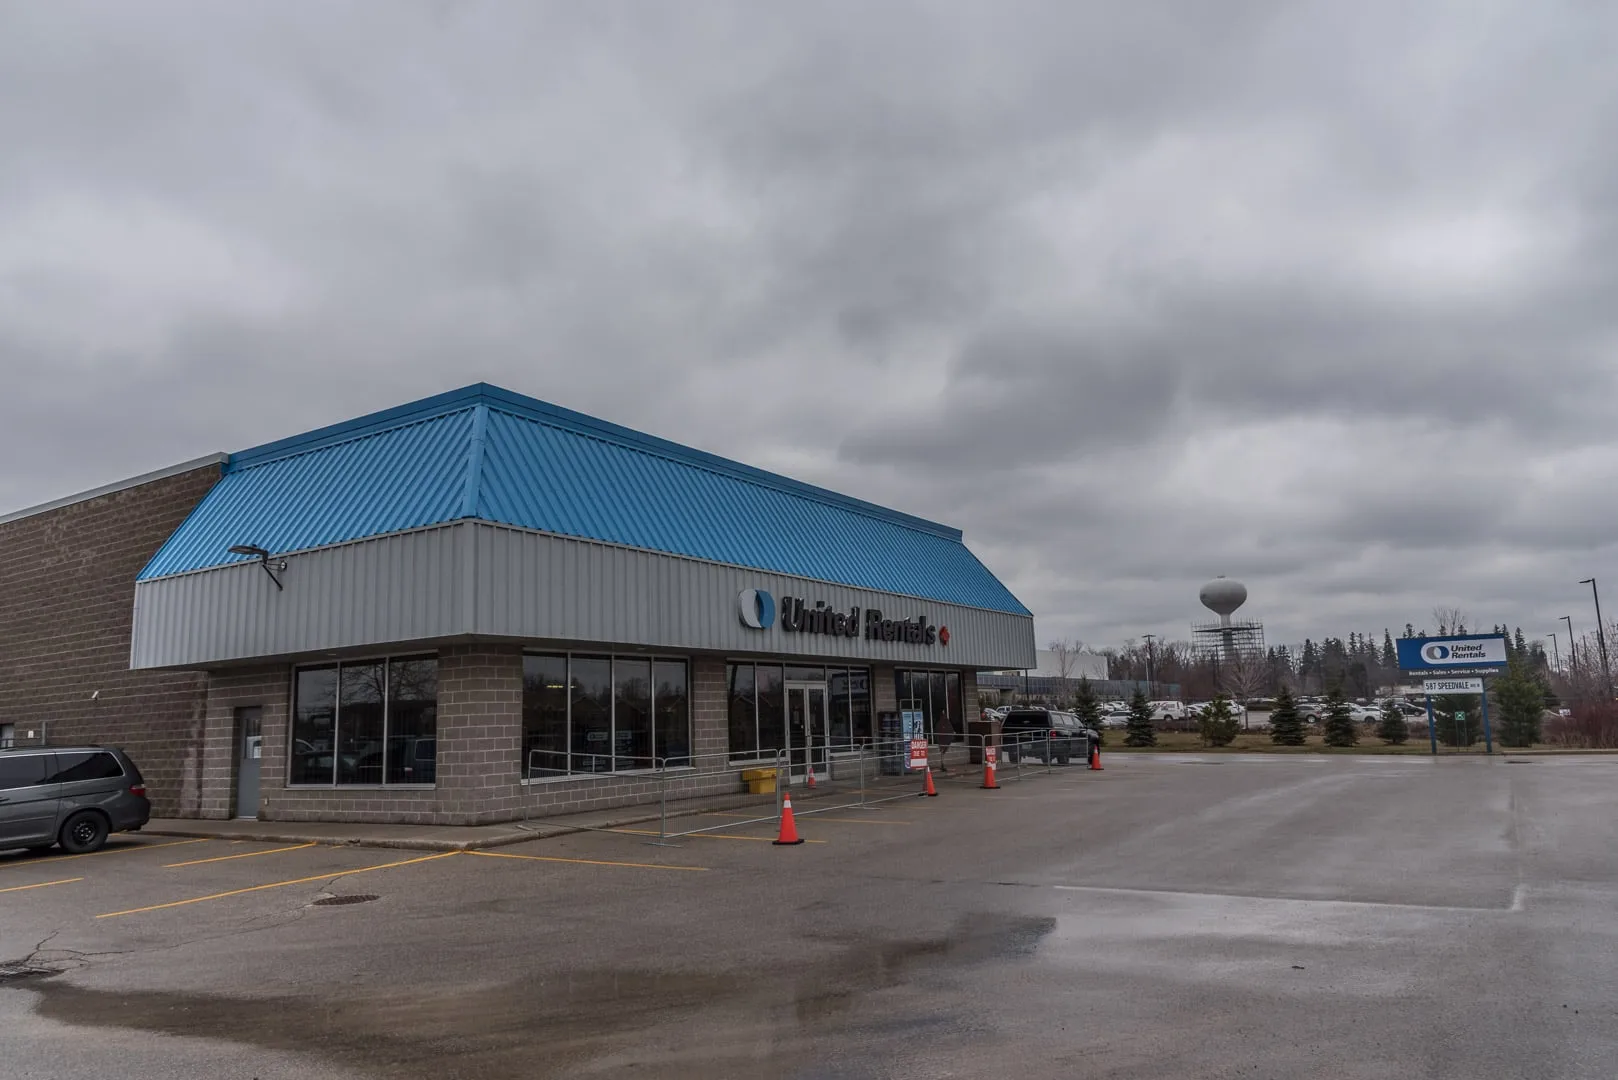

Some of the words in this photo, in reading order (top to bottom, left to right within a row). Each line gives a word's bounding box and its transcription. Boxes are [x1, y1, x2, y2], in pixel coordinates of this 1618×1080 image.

[782, 597, 860, 637] United
[865, 609, 936, 645] Rentals
[1451, 643, 1482, 652] United
[1451, 651, 1486, 659] Rentals
[1425, 682, 1436, 690] 587
[1437, 681, 1469, 690] SPEEDVALE
[911, 741, 927, 749] DANGER
